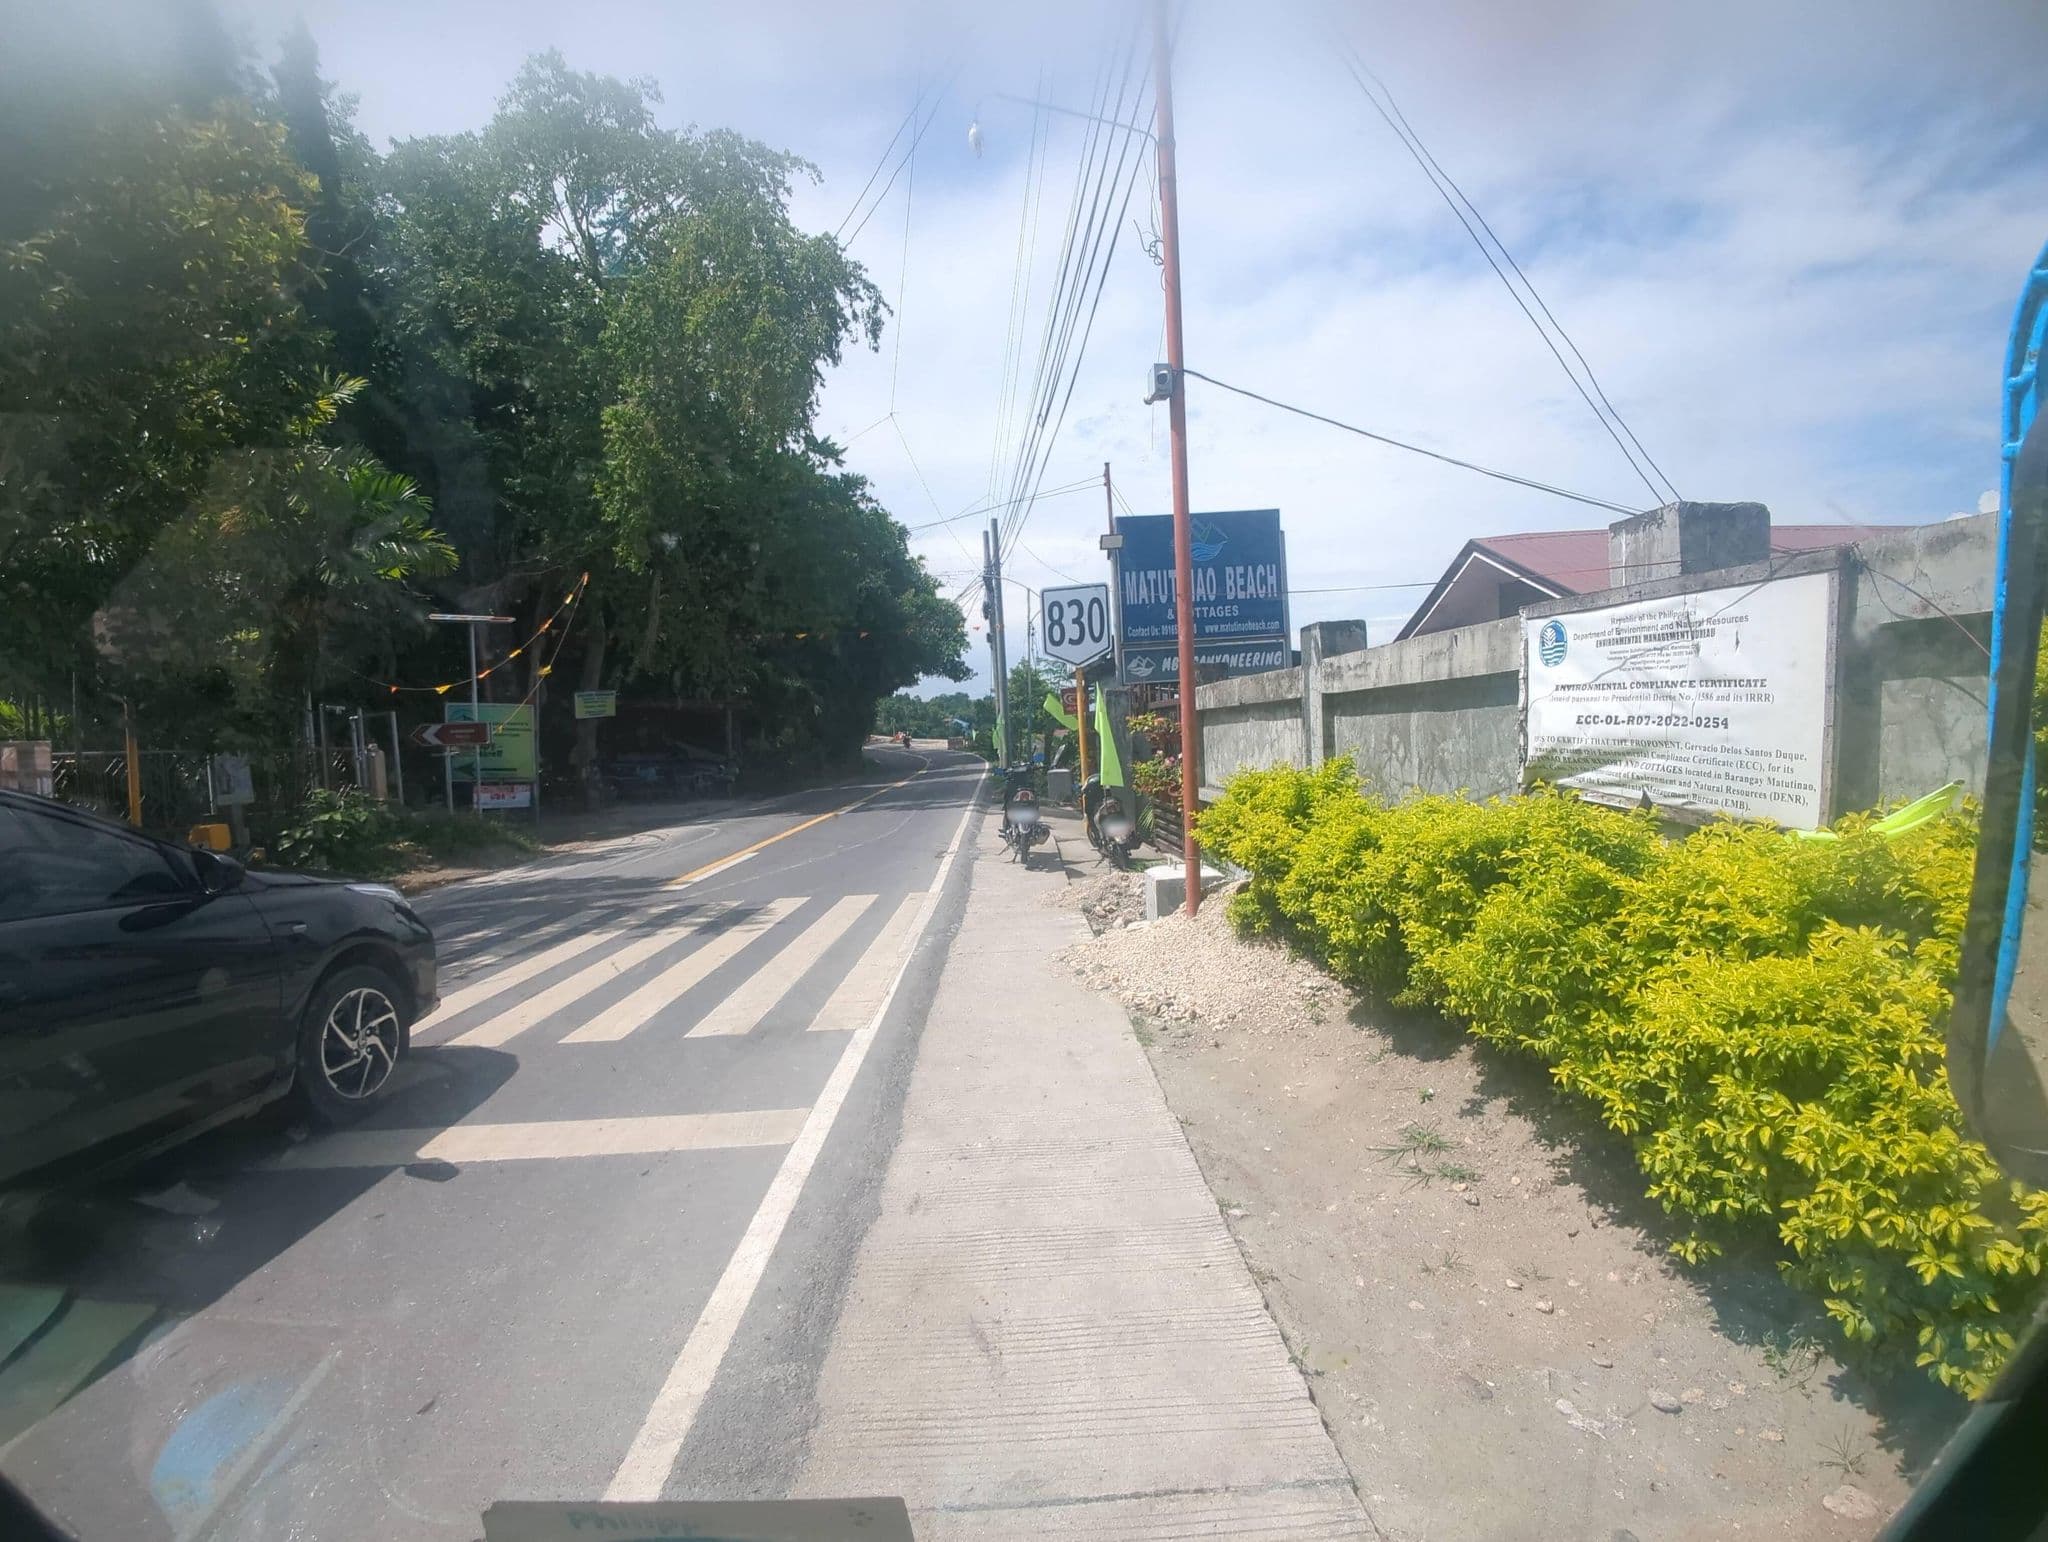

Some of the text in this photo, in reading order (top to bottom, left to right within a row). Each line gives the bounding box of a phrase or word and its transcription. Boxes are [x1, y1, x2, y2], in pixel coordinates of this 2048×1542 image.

[1124, 563, 1278, 605] MATUTAO BEACH
[1047, 596, 1105, 647] 830
[1167, 605, 1239, 620] & TTAGES
[1638, 612, 1646, 621] of
[1647, 611, 1657, 620] the
[1127, 624, 1150, 637] Contact
[1151, 623, 1161, 636] Us:
[1573, 614, 1750, 641] Department of Environment and Natural Resources
[1595, 634, 1642, 648] ENVIRONMENTAL
[1643, 630, 1690, 643] MANAGEMENT
[1554, 678, 1768, 691] ENVIRONMENTAL COMPLIANCE CERTIFICATE
[1602, 694, 1610, 702] to
[1611, 692, 1651, 703] Presidential
[1653, 692, 1677, 702] Decree
[1678, 691, 1694, 701] No.
[1716, 692, 1731, 702] and
[1732, 692, 1743, 702] its
[1745, 692, 1775, 704] IRRR)
[1575, 714, 1729, 729] ECC-OL-R07-2022-0254
[1546, 735, 1556, 743] TO
[1557, 735, 1588, 745] CERTIFY
[1590, 737, 1609, 746] THAT
[1685, 741, 1718, 753] Gervacio
[1720, 744, 1742, 755] Delos
[1744, 747, 1772, 758] Santos
[1775, 749, 1808, 762] Duque,
[1651, 751, 1690, 763] Compliance
[1692, 754, 1735, 768] Certificate
[1736, 759, 1765, 773] (ECC),
[1768, 762, 1781, 773] for
[1783, 763, 1795, 774] its
[1640, 761, 1683, 774] COTTAGES
[1685, 766, 1712, 779] located
[1714, 771, 1722, 779] in
[1725, 771, 1763, 787] Barangay
[1766, 776, 1817, 792] Matutinao,
[1631, 772, 1676, 785] Environment
[1679, 779, 1692, 788] and
[1694, 781, 1723, 793] Natural
[1726, 785, 1767, 799] Resources
[1769, 791, 1809, 807] (DENR),
[1692, 793, 1719, 805] Bureau
[1720, 798, 1751, 812] (EMB).
